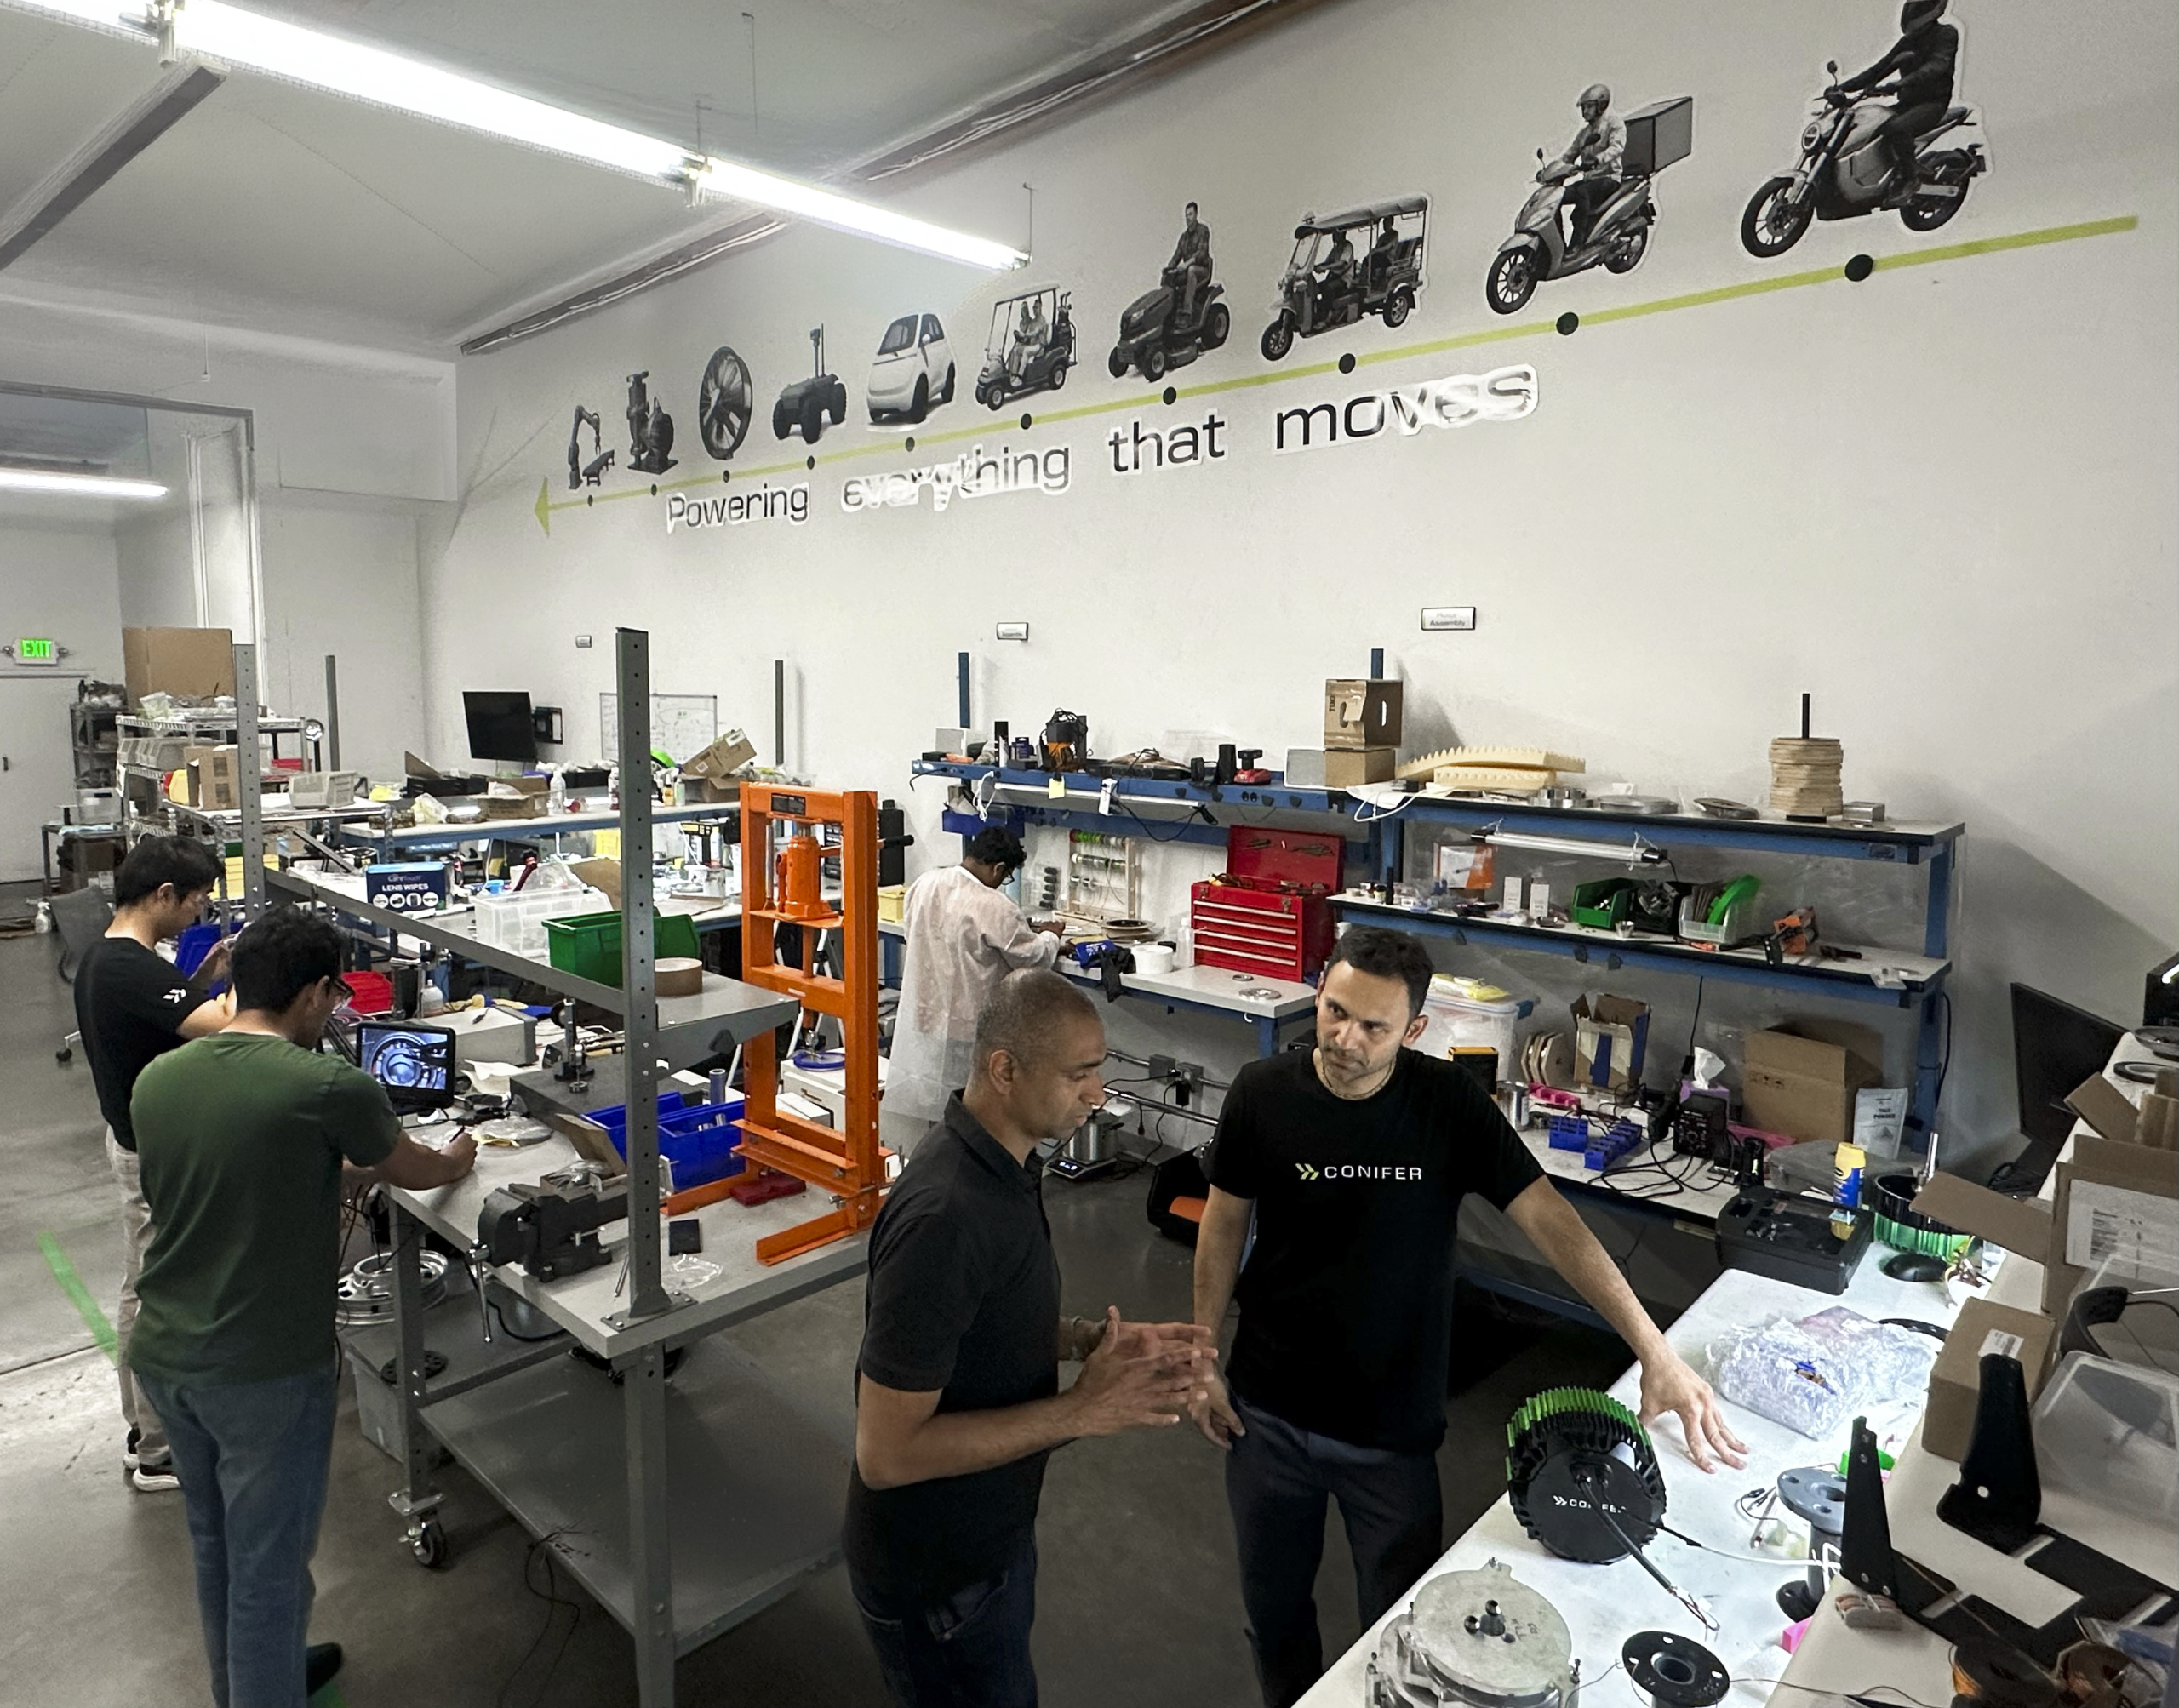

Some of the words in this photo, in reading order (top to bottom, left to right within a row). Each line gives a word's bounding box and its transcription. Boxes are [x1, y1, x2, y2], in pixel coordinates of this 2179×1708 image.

[667, 483, 809, 528] Powering
[1108, 414, 1226, 473] that
[1276, 369, 1534, 449] moves
[22, 640, 52, 658] EXIT
[1324, 1165, 1421, 1180] CONIFER
[1569, 1499, 1627, 1514] COFE
